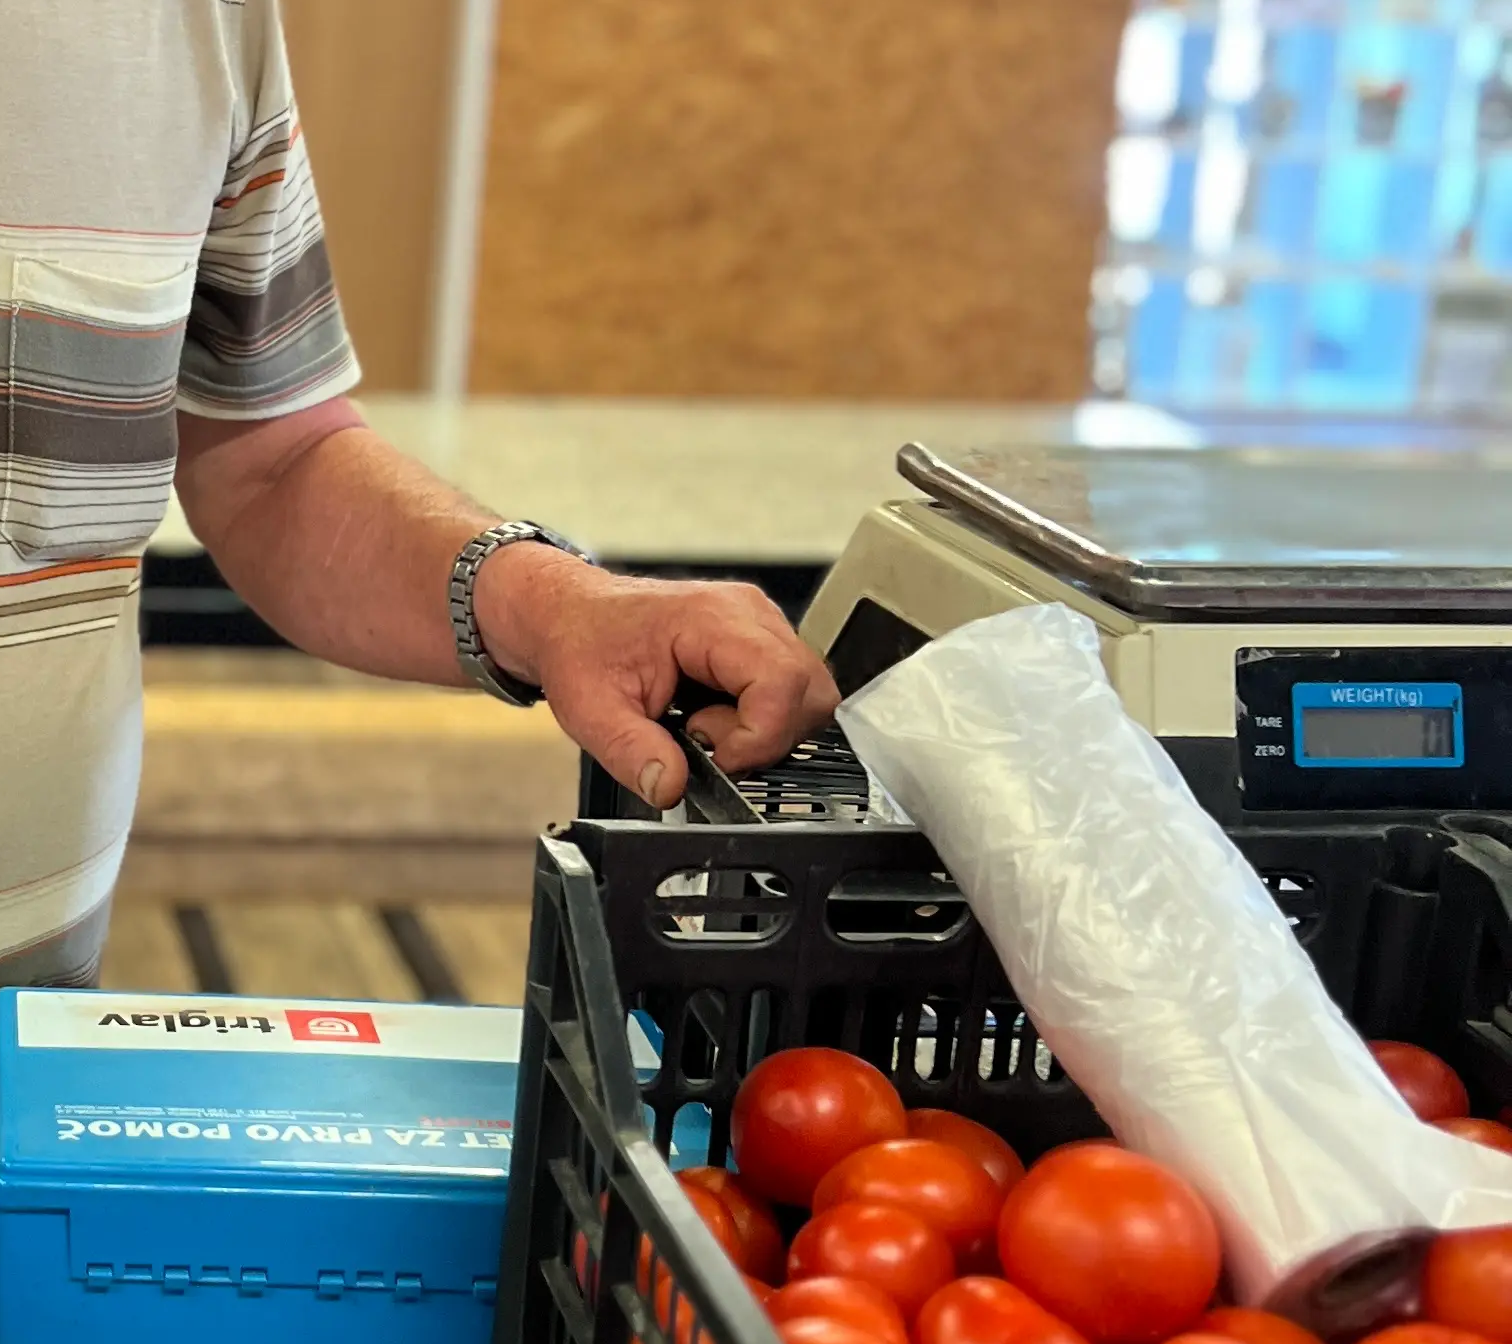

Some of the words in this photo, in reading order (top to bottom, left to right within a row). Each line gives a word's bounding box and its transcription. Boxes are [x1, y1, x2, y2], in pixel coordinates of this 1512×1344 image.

[1330, 687, 1424, 706] WEIGHT(kg)
[1254, 716, 1283, 728] TARE
[1254, 744, 1286, 756] ZERO
[98, 1008, 276, 1034] triglav
[55, 1119, 232, 1140] POMOČ
[245, 1123, 373, 1145] PRVO
[384, 1128, 446, 1147] ZA
[459, 1130, 514, 1150] ET
